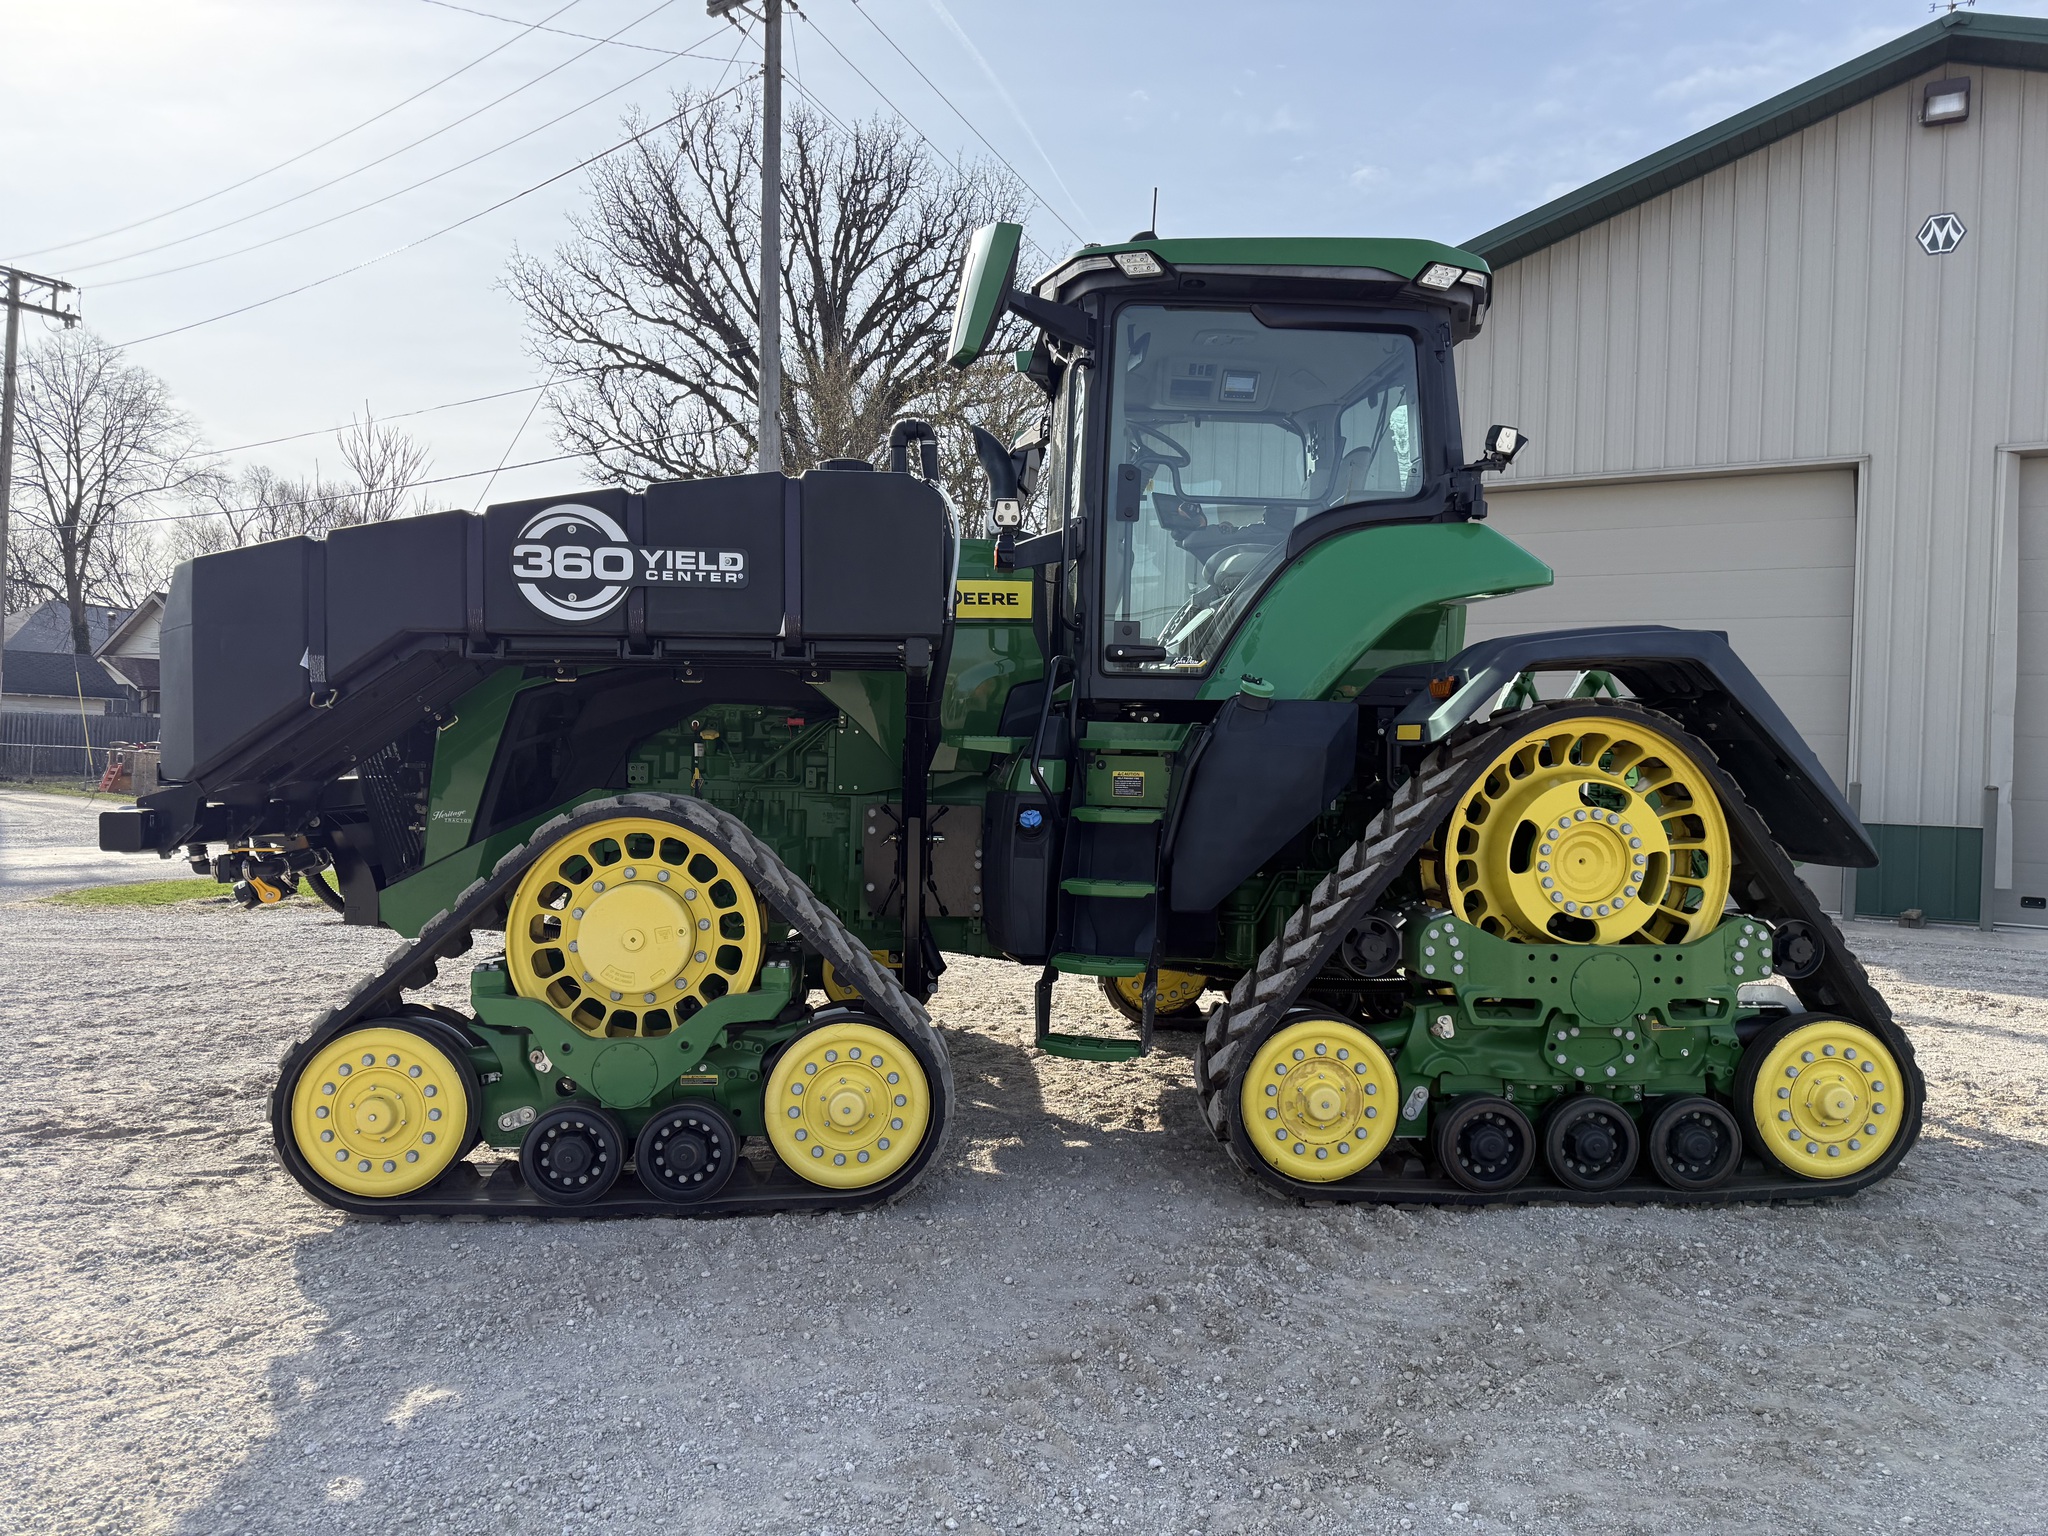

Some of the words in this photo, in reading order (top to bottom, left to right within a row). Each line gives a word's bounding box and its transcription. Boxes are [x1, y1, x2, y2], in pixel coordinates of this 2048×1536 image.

[513, 544, 634, 581] 360
[639, 549, 744, 571] YIELD
[431, 810, 467, 821] Heritage
